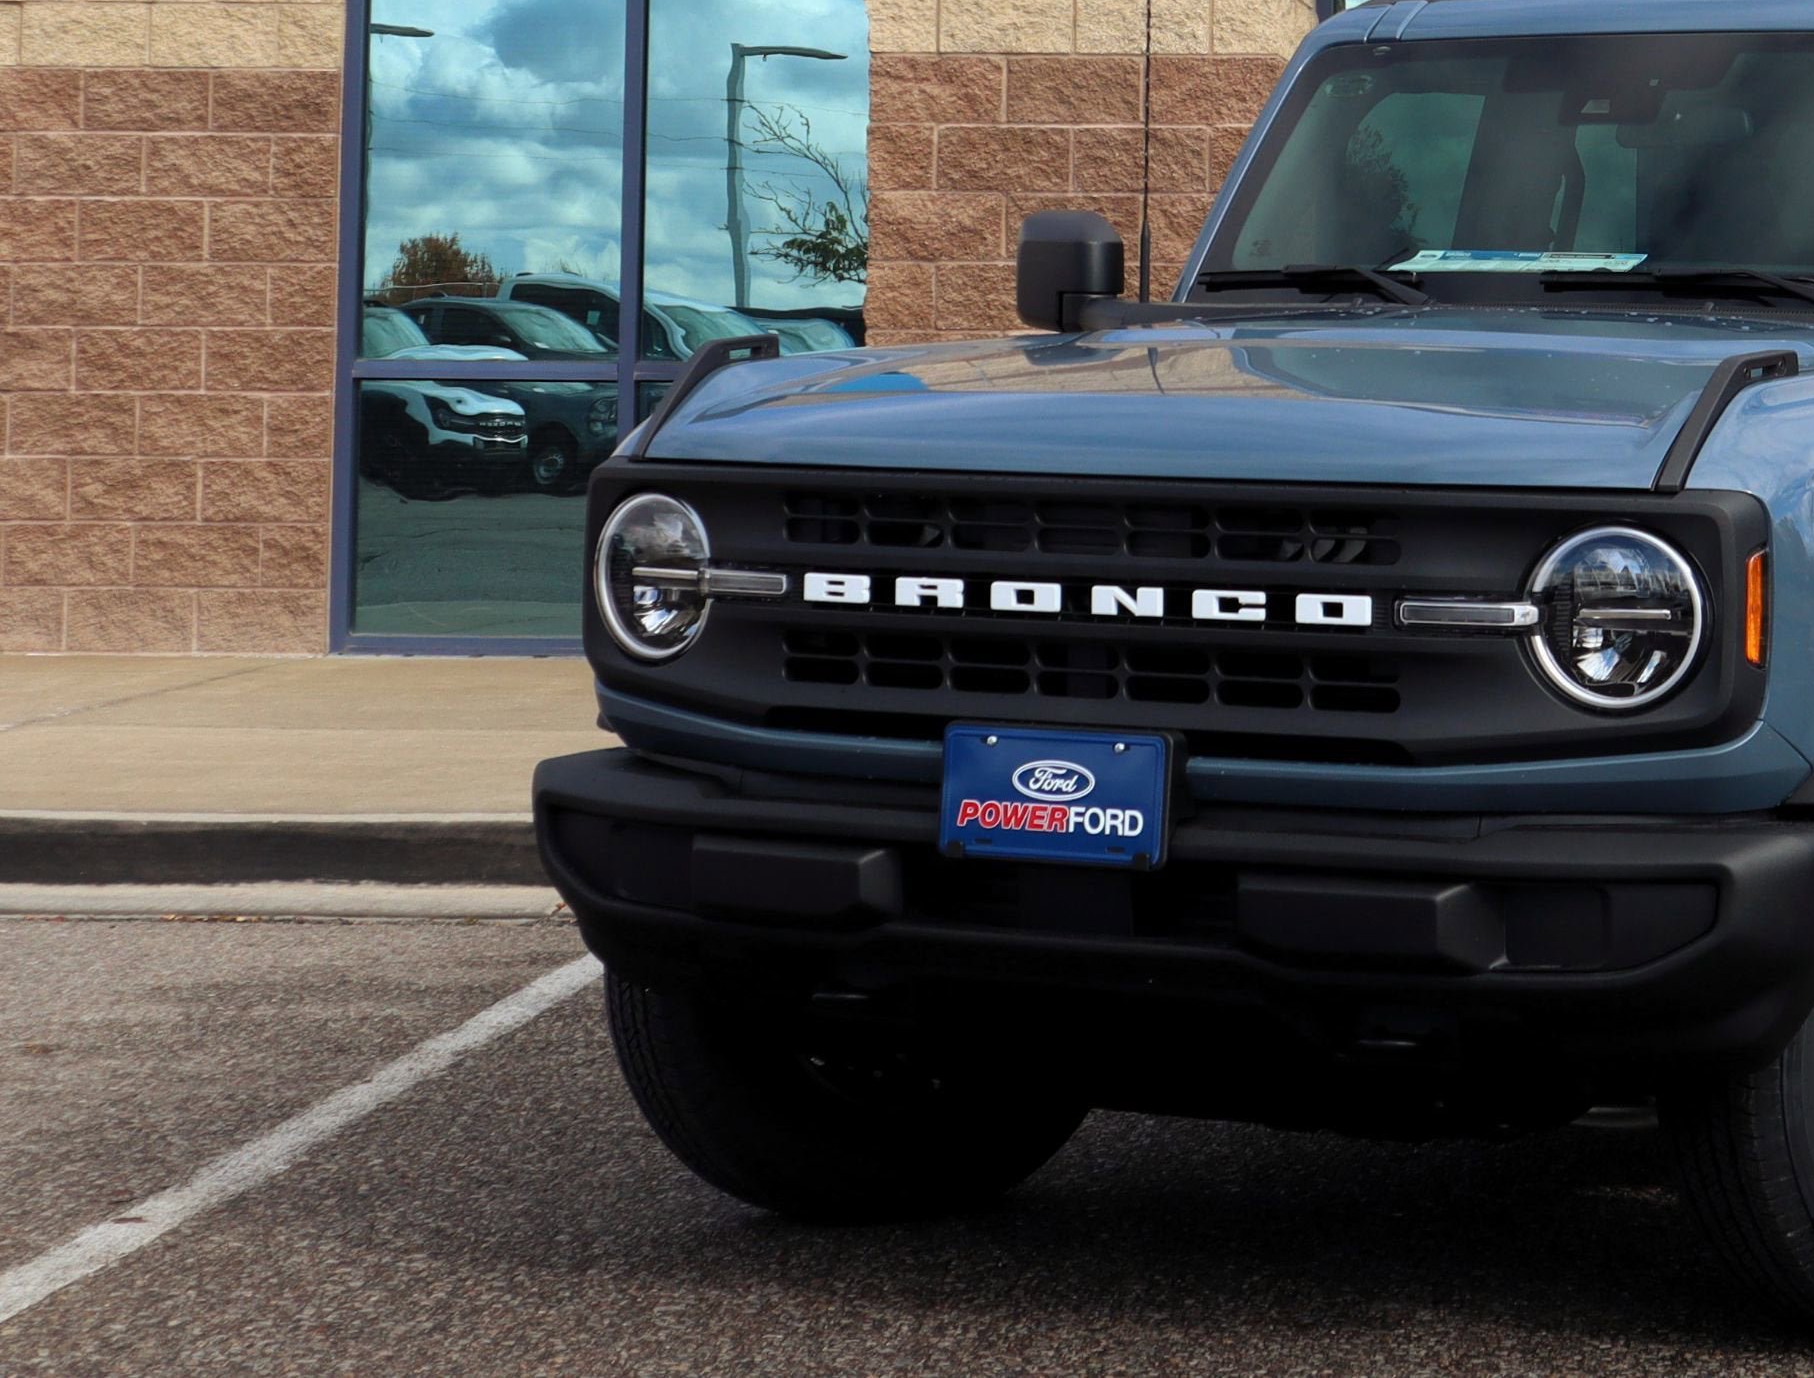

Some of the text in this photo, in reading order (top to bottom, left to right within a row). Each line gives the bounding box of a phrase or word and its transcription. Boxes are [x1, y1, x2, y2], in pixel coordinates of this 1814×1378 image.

[803, 571, 1373, 627] BRONCO
[1028, 766, 1079, 793] Ford
[957, 799, 1145, 838] POWERFORD
